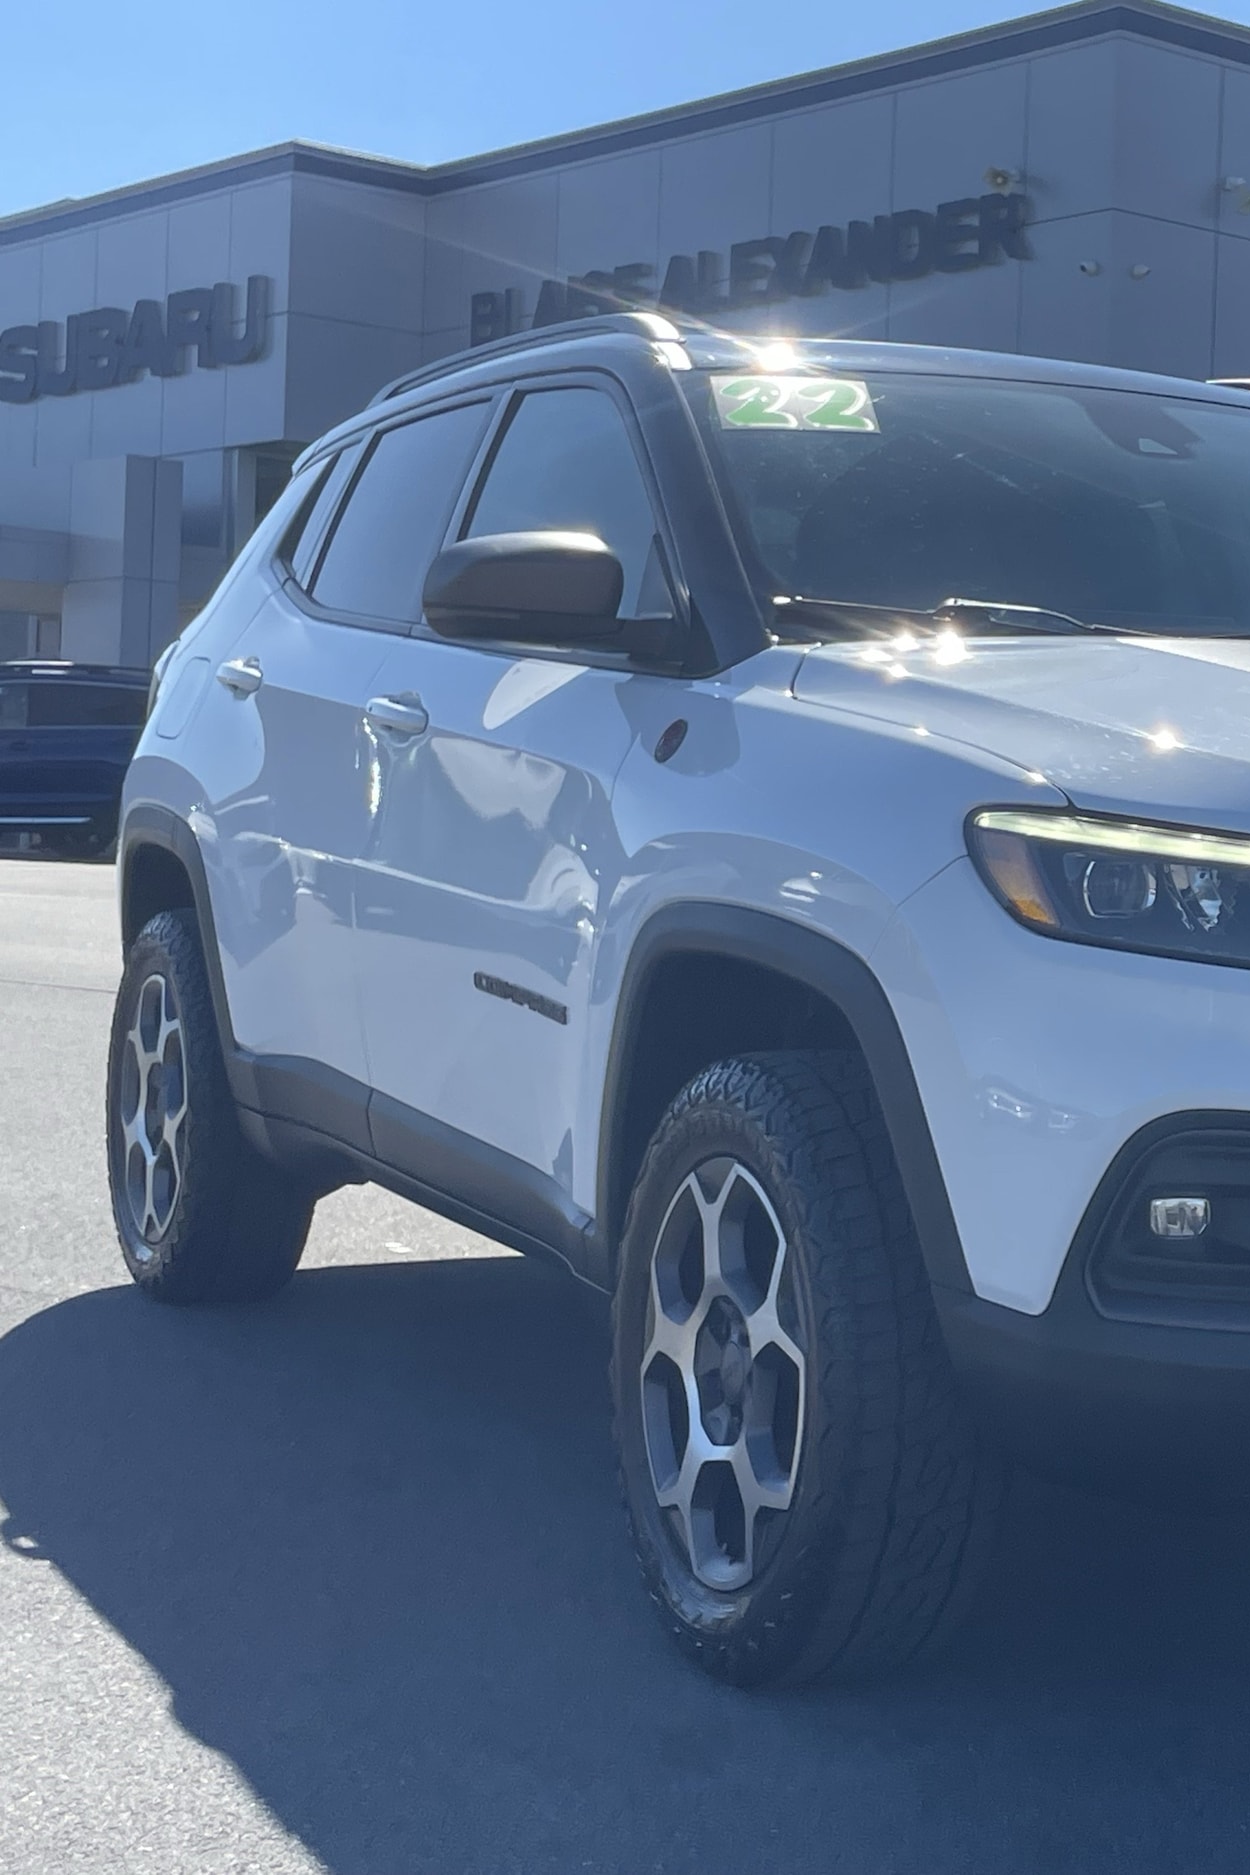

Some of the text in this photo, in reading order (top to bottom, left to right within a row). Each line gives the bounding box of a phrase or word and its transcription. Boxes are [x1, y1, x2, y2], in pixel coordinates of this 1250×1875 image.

[659, 192, 1034, 316] ALEXANDER
[0, 275, 273, 404] SUBARU
[720, 379, 875, 430] 22
